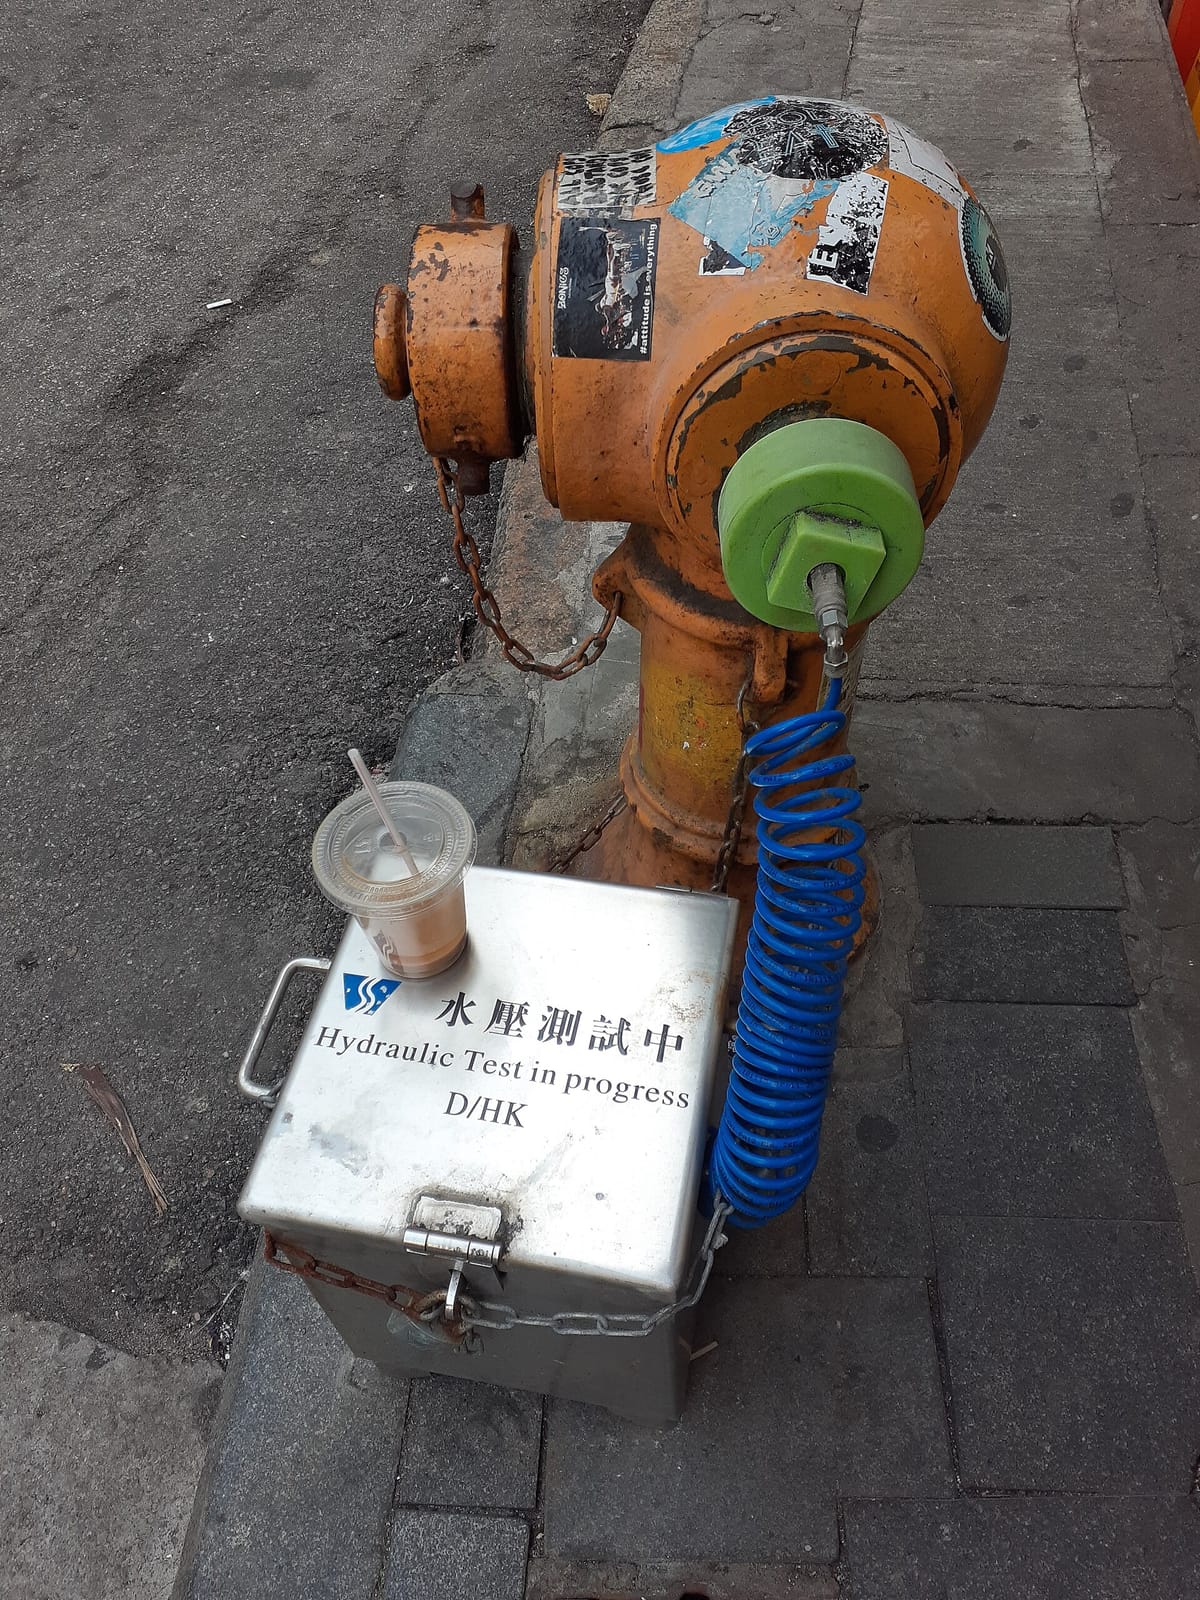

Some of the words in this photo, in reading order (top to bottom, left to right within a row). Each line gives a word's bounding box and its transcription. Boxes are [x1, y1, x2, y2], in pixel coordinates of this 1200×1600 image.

[645, 223, 658, 284] everything
[644, 284, 652, 297] is
[639, 298, 652, 355] #attitude
[436, 991, 686, 1063] 水壓測試中
[313, 1026, 455, 1068] Hydraulic
[465, 1050, 523, 1080] Test
[531, 1063, 558, 1085] in
[564, 1071, 690, 1109] progress
[443, 1090, 529, 1129] D/HK
